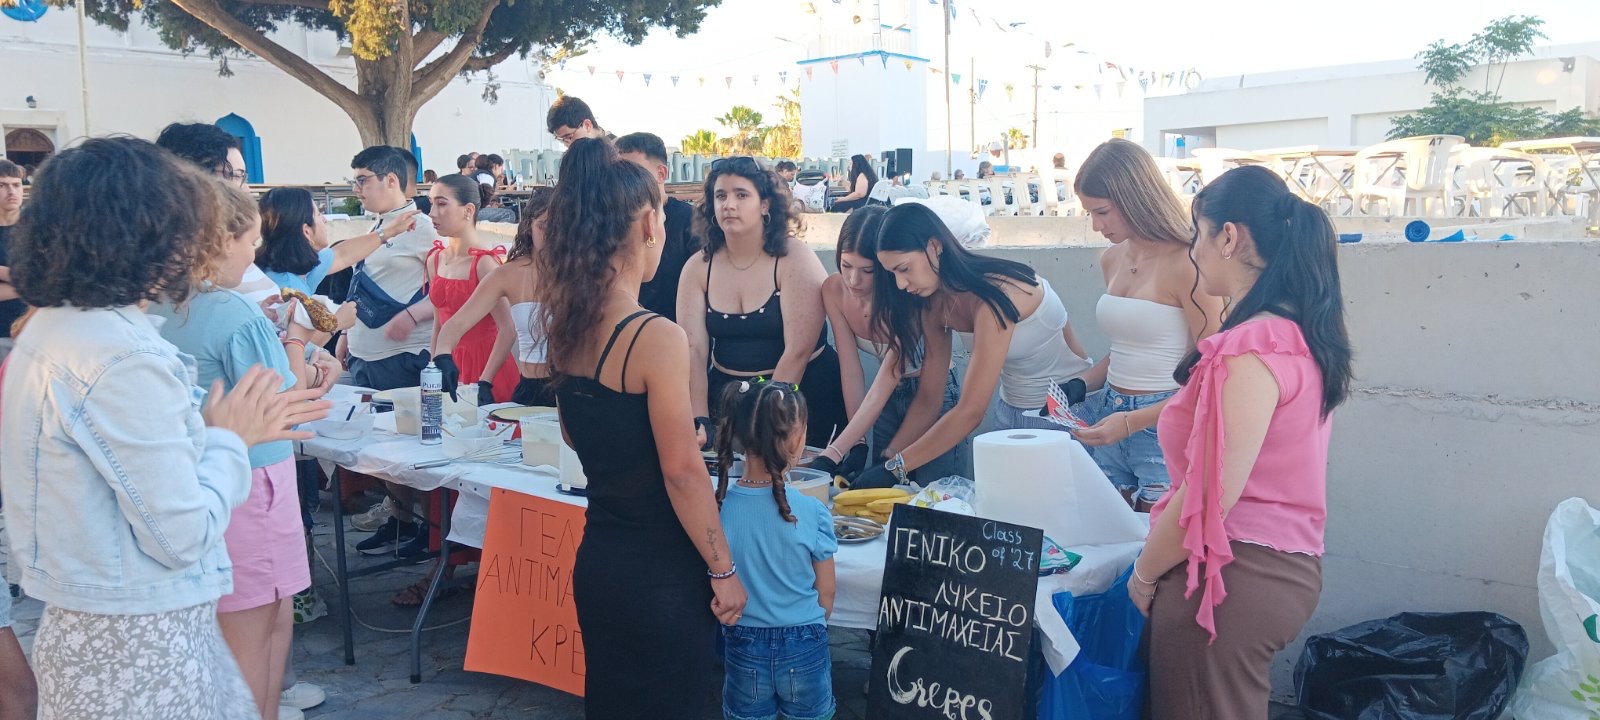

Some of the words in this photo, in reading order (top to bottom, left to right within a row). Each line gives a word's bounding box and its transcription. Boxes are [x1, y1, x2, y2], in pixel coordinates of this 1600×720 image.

[894, 527, 986, 574] ΓΕΝΙΚΟ
[982, 521, 1022, 545] Class
[991, 546, 1006, 567] of
[934, 579, 1027, 627] ΛΥΚΕΙΟ
[878, 596, 1023, 662] ΑΝΤΙΜΑΧΕΙΑΣ
